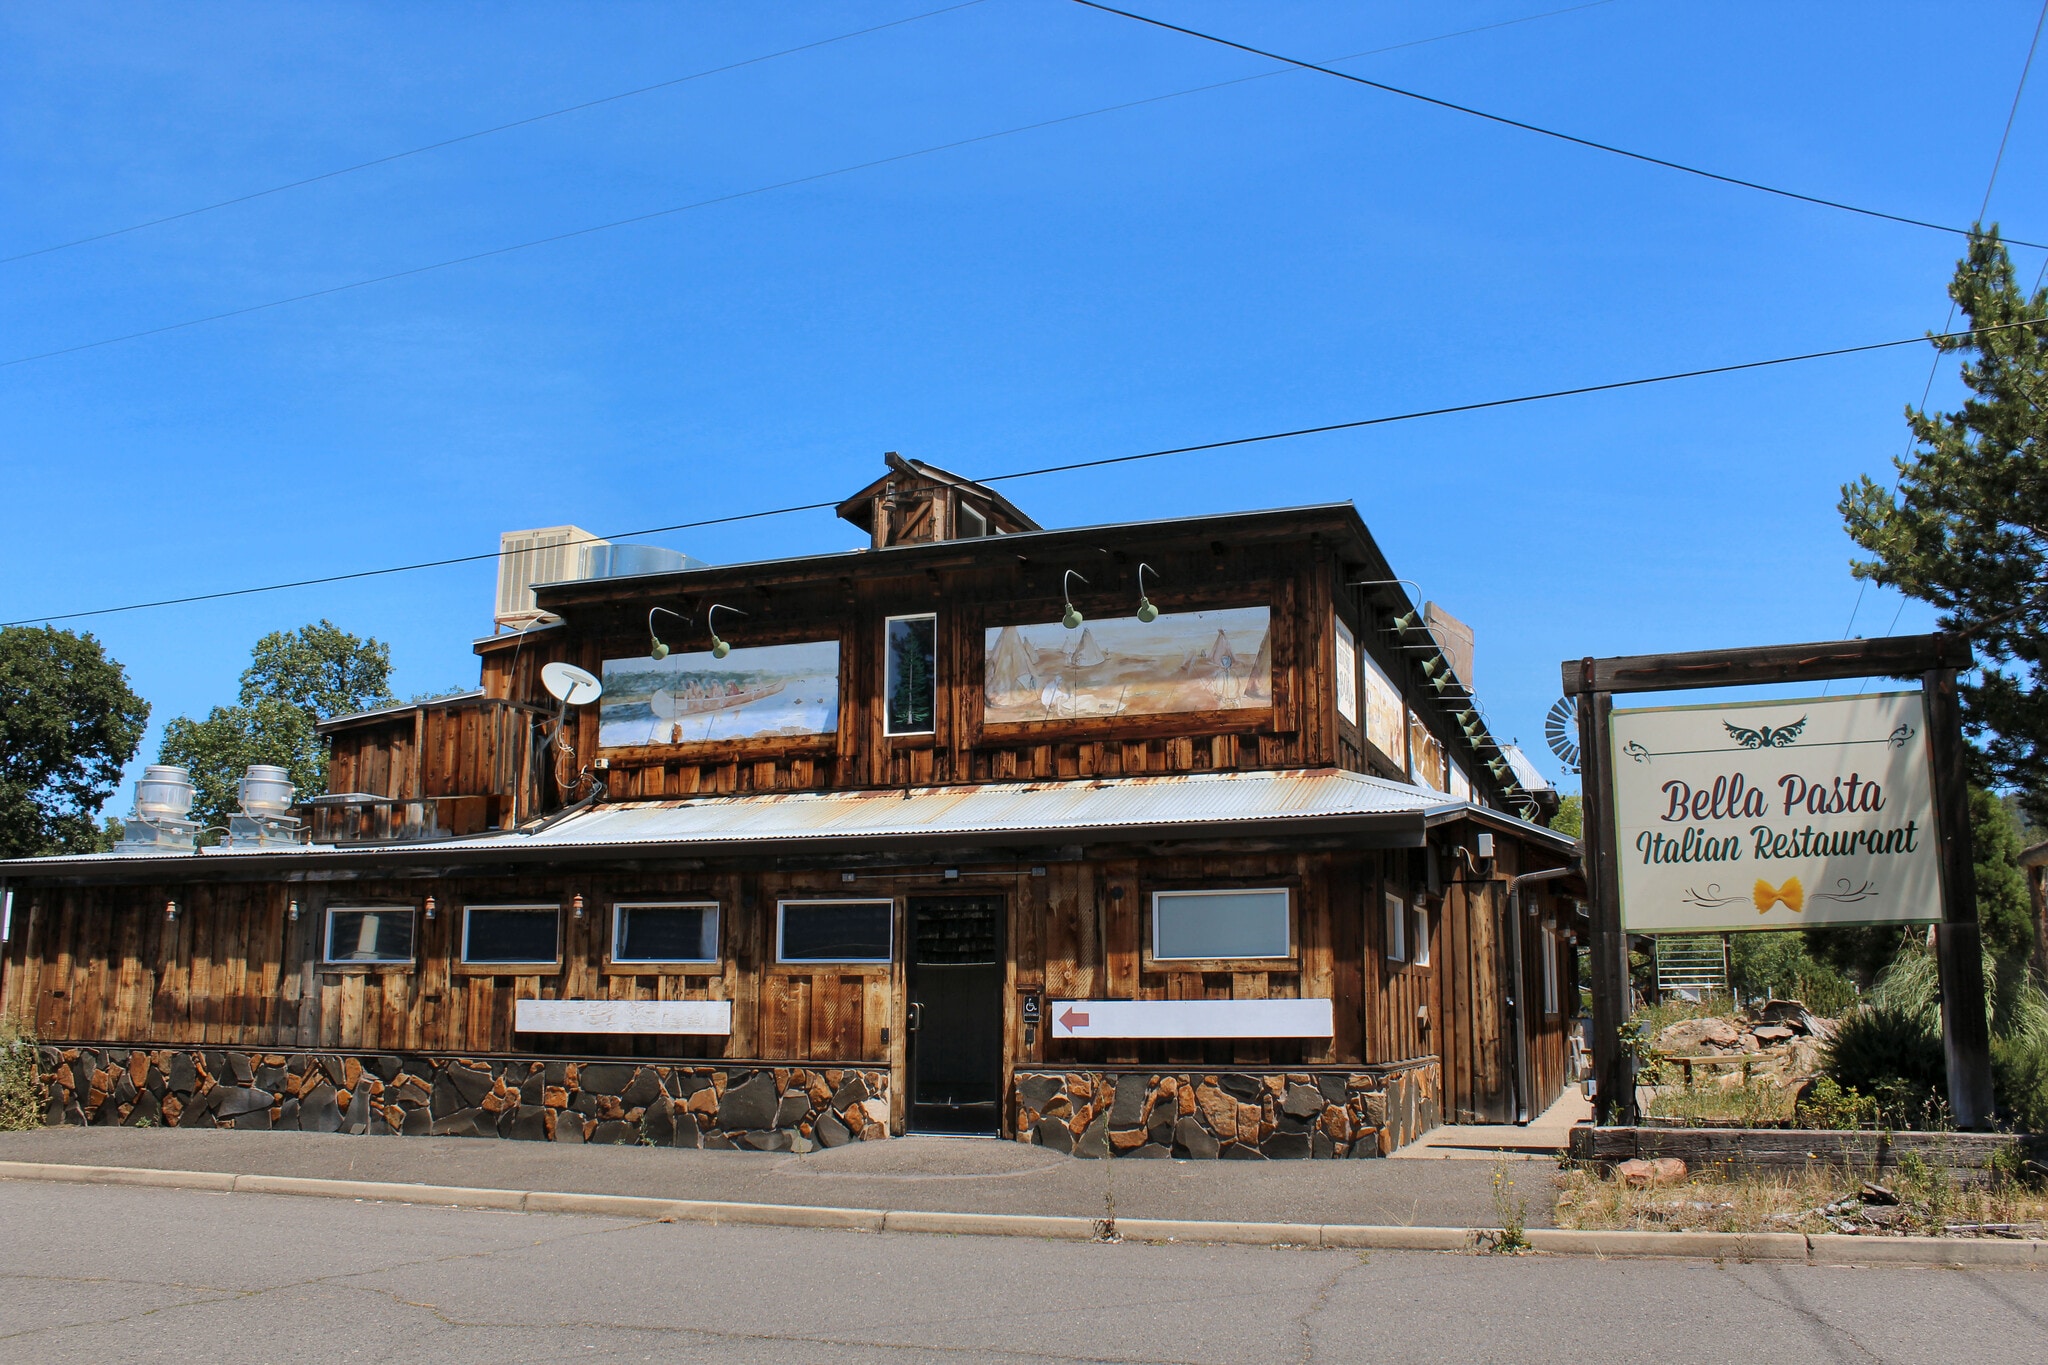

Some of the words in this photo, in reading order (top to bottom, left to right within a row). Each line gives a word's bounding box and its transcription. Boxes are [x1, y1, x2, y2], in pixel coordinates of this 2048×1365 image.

[1661, 773, 1768, 822] Bella
[1778, 773, 1886, 816] Pasta
[1636, 827, 1742, 864] Italian
[1750, 821, 1918, 860] Restaurant
